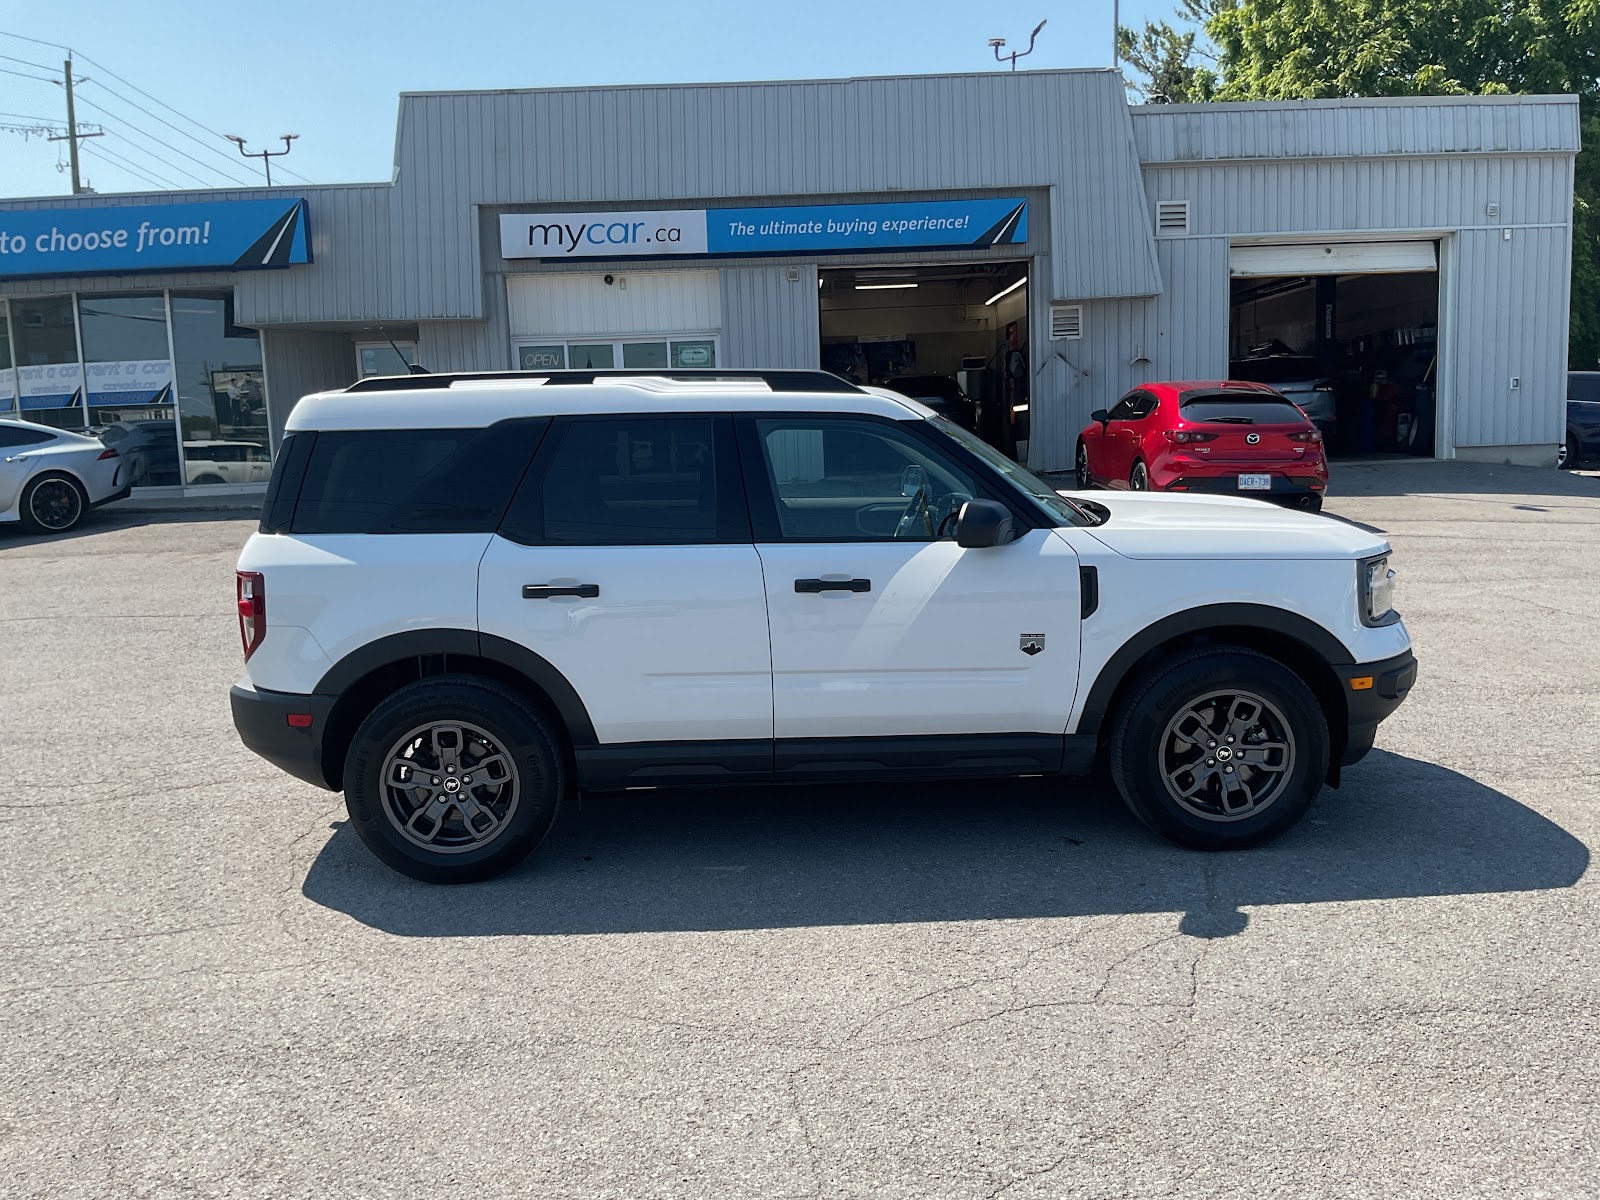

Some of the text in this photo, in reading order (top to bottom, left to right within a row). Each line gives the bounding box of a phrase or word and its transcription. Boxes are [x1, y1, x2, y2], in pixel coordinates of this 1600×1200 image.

[729, 215, 970, 236] The ultimate buying experience!
[0, 221, 211, 254] to choose from!
[528, 222, 681, 253] mycar.ca
[86, 361, 121, 376] rent
[525, 353, 560, 366] OPEN
